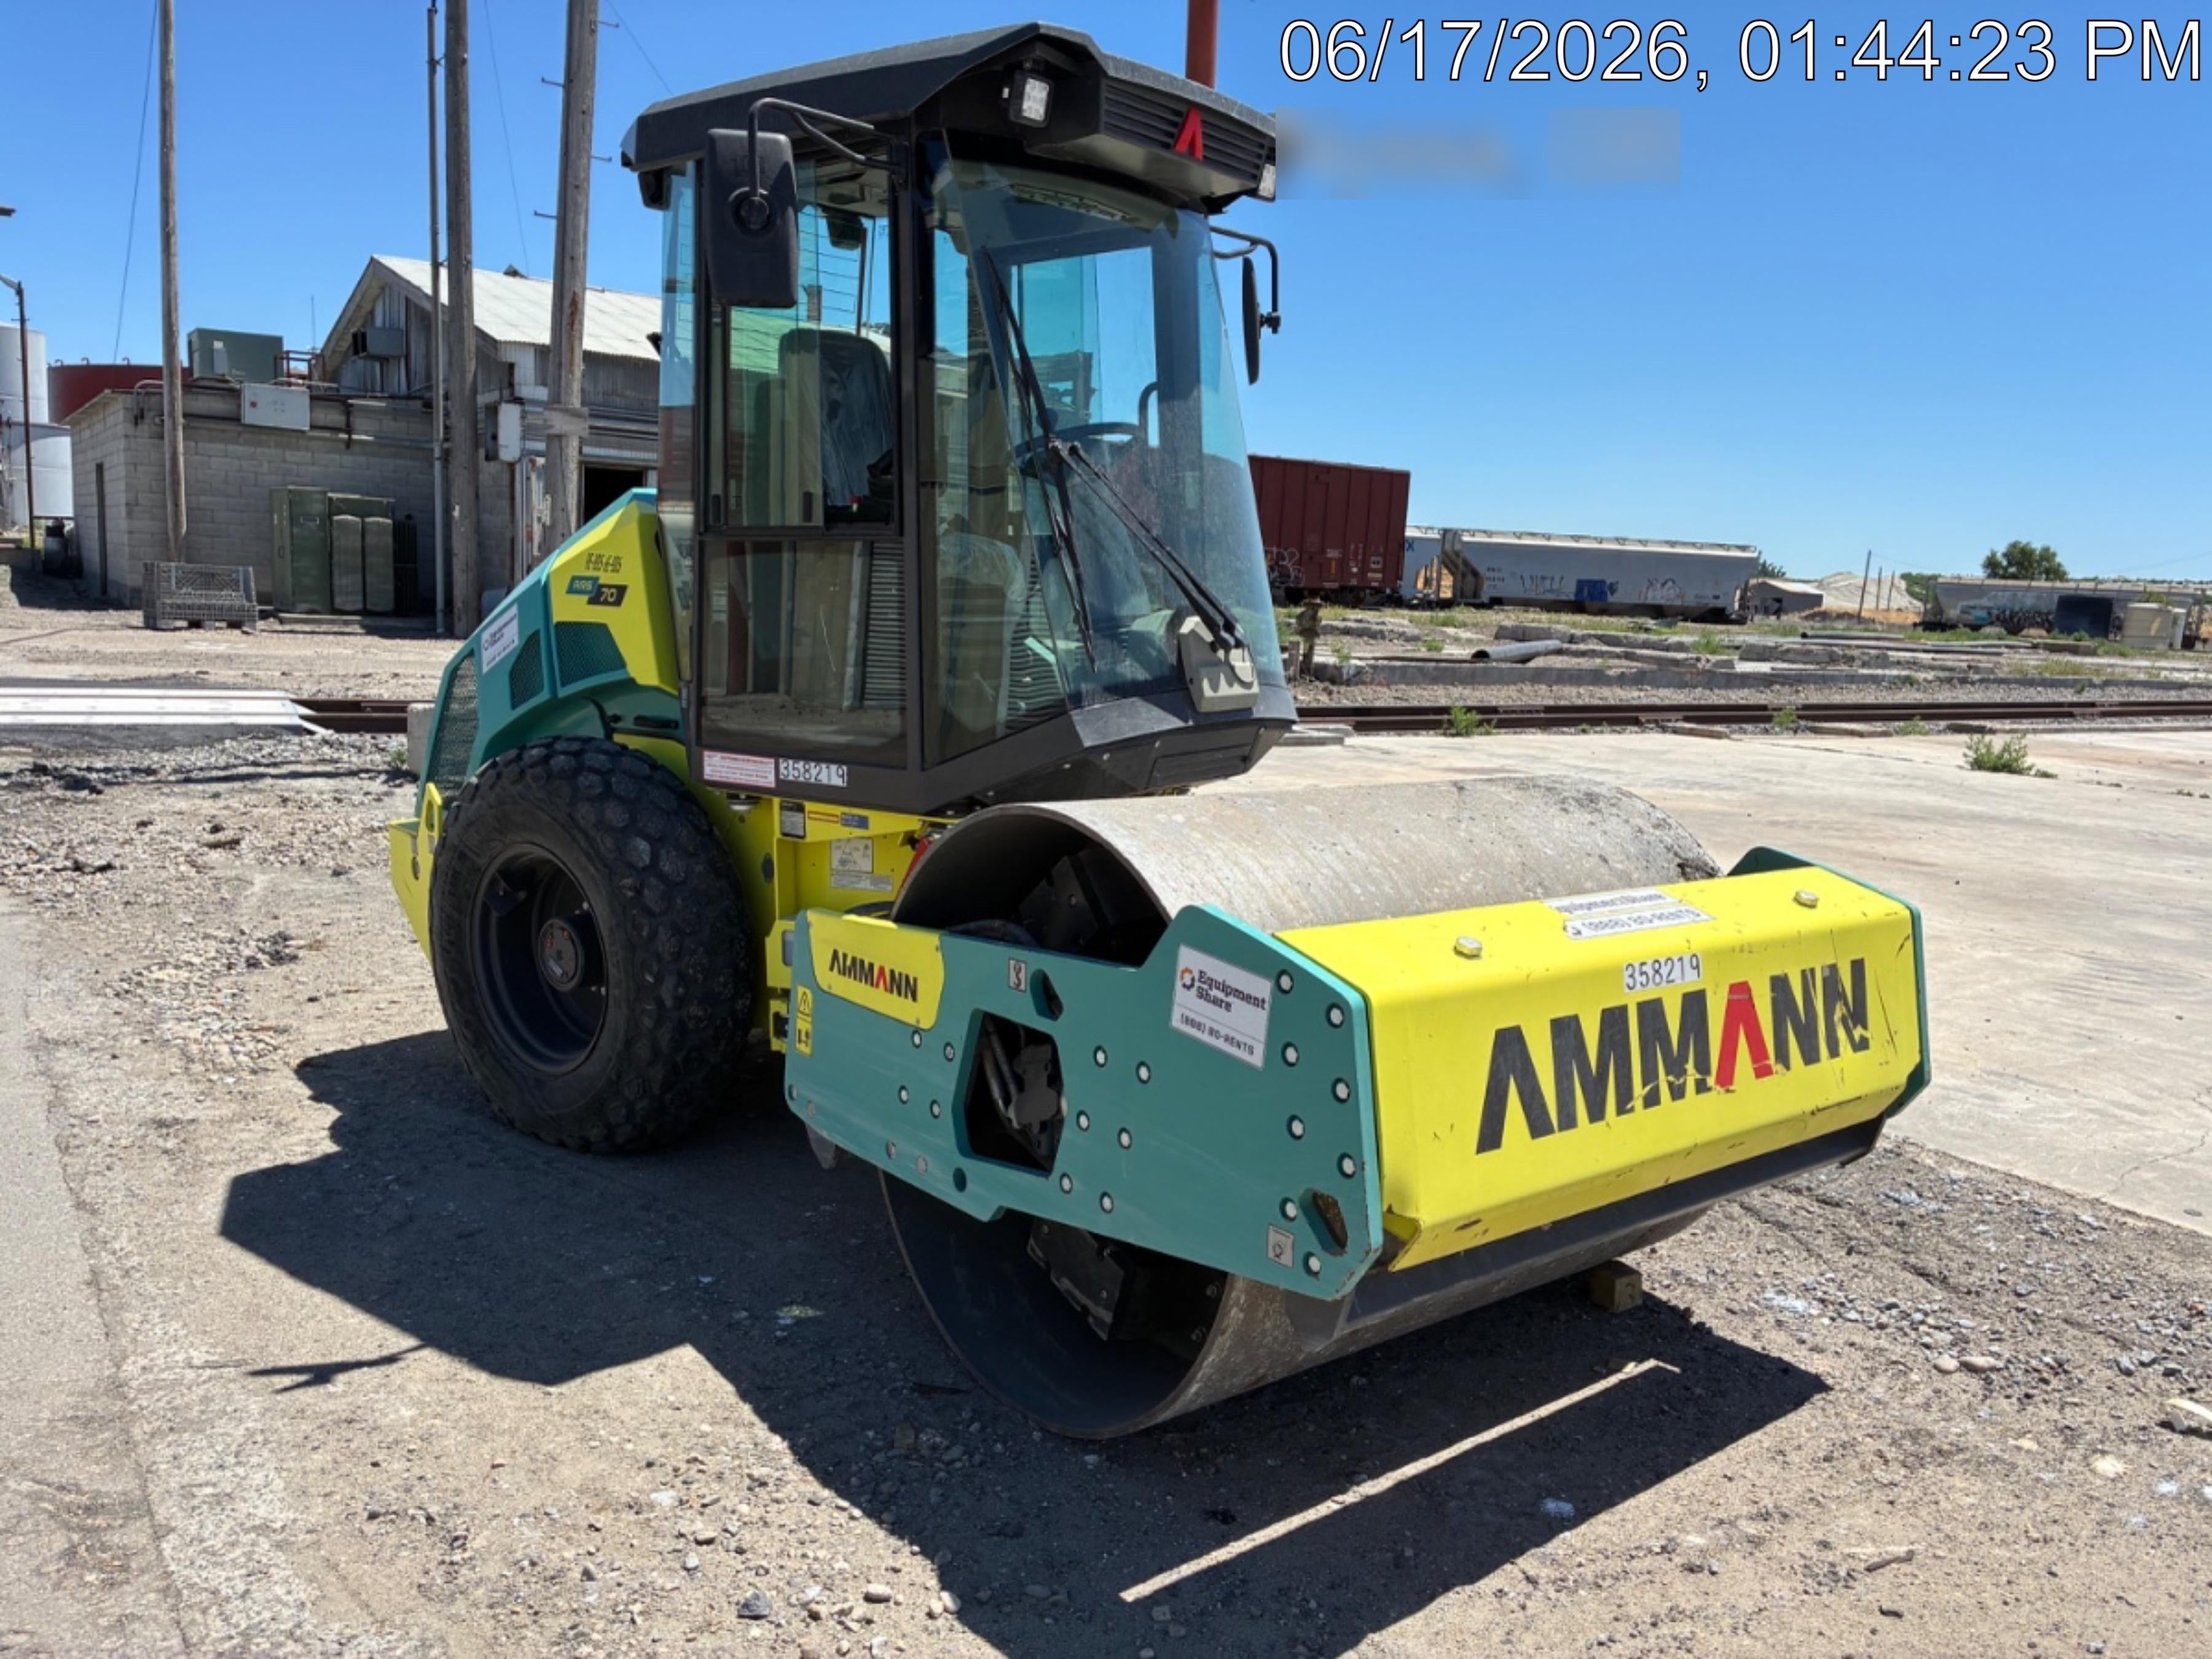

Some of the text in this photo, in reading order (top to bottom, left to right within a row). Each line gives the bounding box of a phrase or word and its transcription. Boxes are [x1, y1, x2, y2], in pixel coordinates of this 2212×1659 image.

[600, 588, 617, 602] 70
[781, 759, 845, 785] 358219
[830, 949, 918, 1002] AMMANN
[1198, 970, 1266, 1010] Equipment
[1626, 954, 1701, 990] 358219
[1197, 986, 1232, 1012] Share
[1477, 958, 1870, 1154] AMMANN
